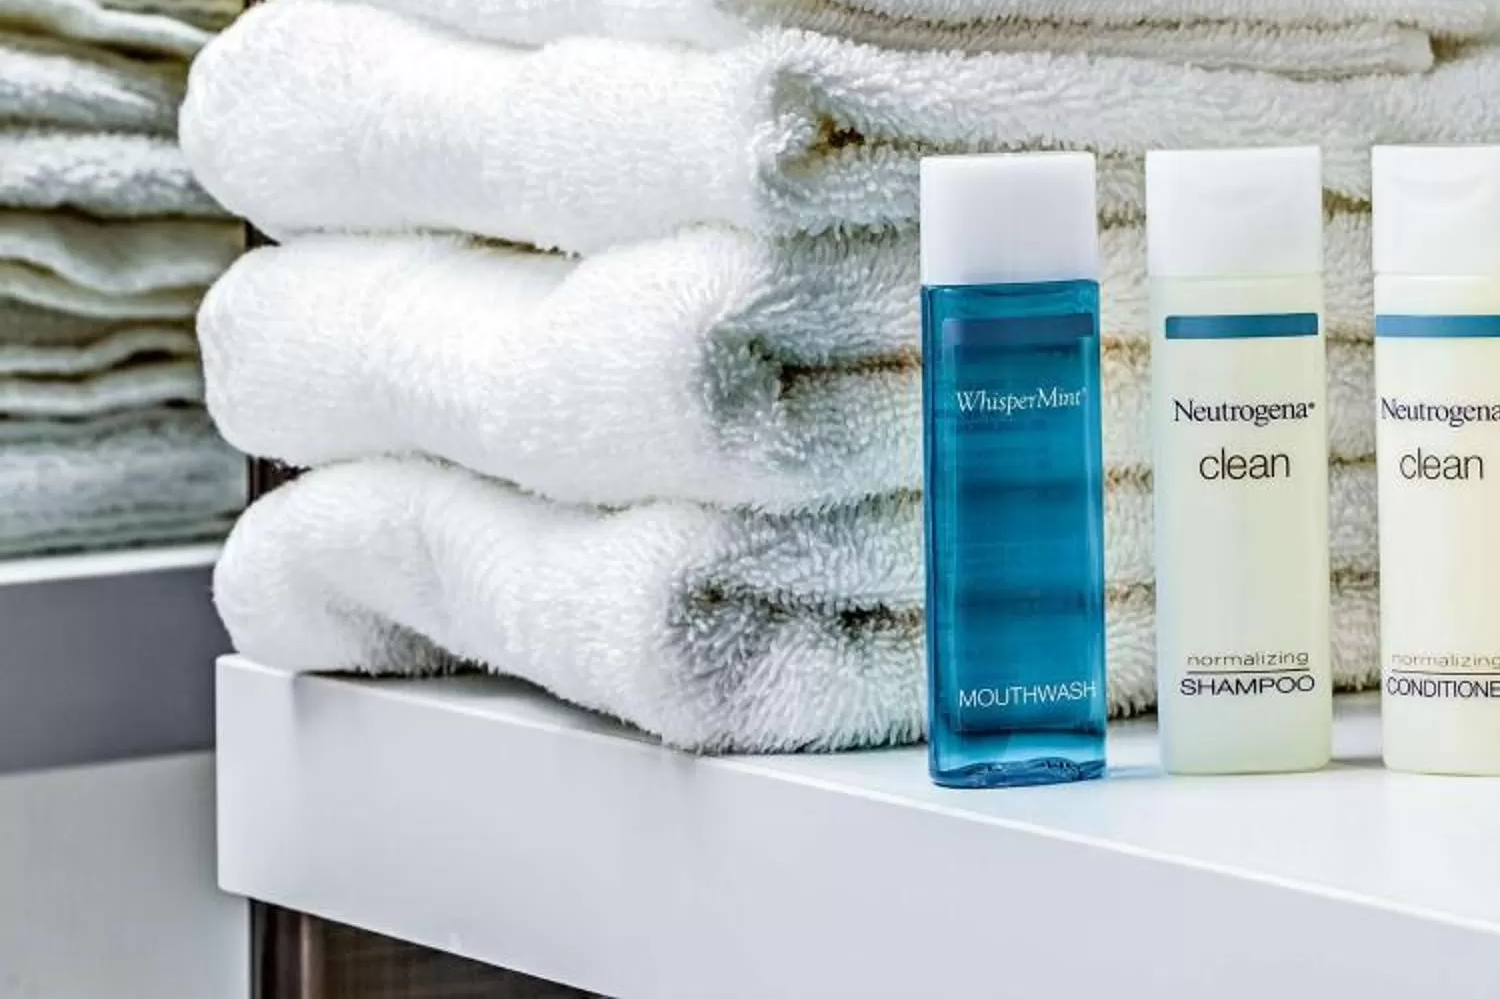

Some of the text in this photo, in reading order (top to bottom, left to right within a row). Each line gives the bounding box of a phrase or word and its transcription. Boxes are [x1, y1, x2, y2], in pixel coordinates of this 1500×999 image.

[1199, 446, 1290, 480] clean
[1399, 446, 1484, 480] clean
[1187, 651, 1310, 667] normalizing
[958, 680, 1097, 708] MOUTHWASH
[1180, 674, 1316, 696] SHAMPOO
